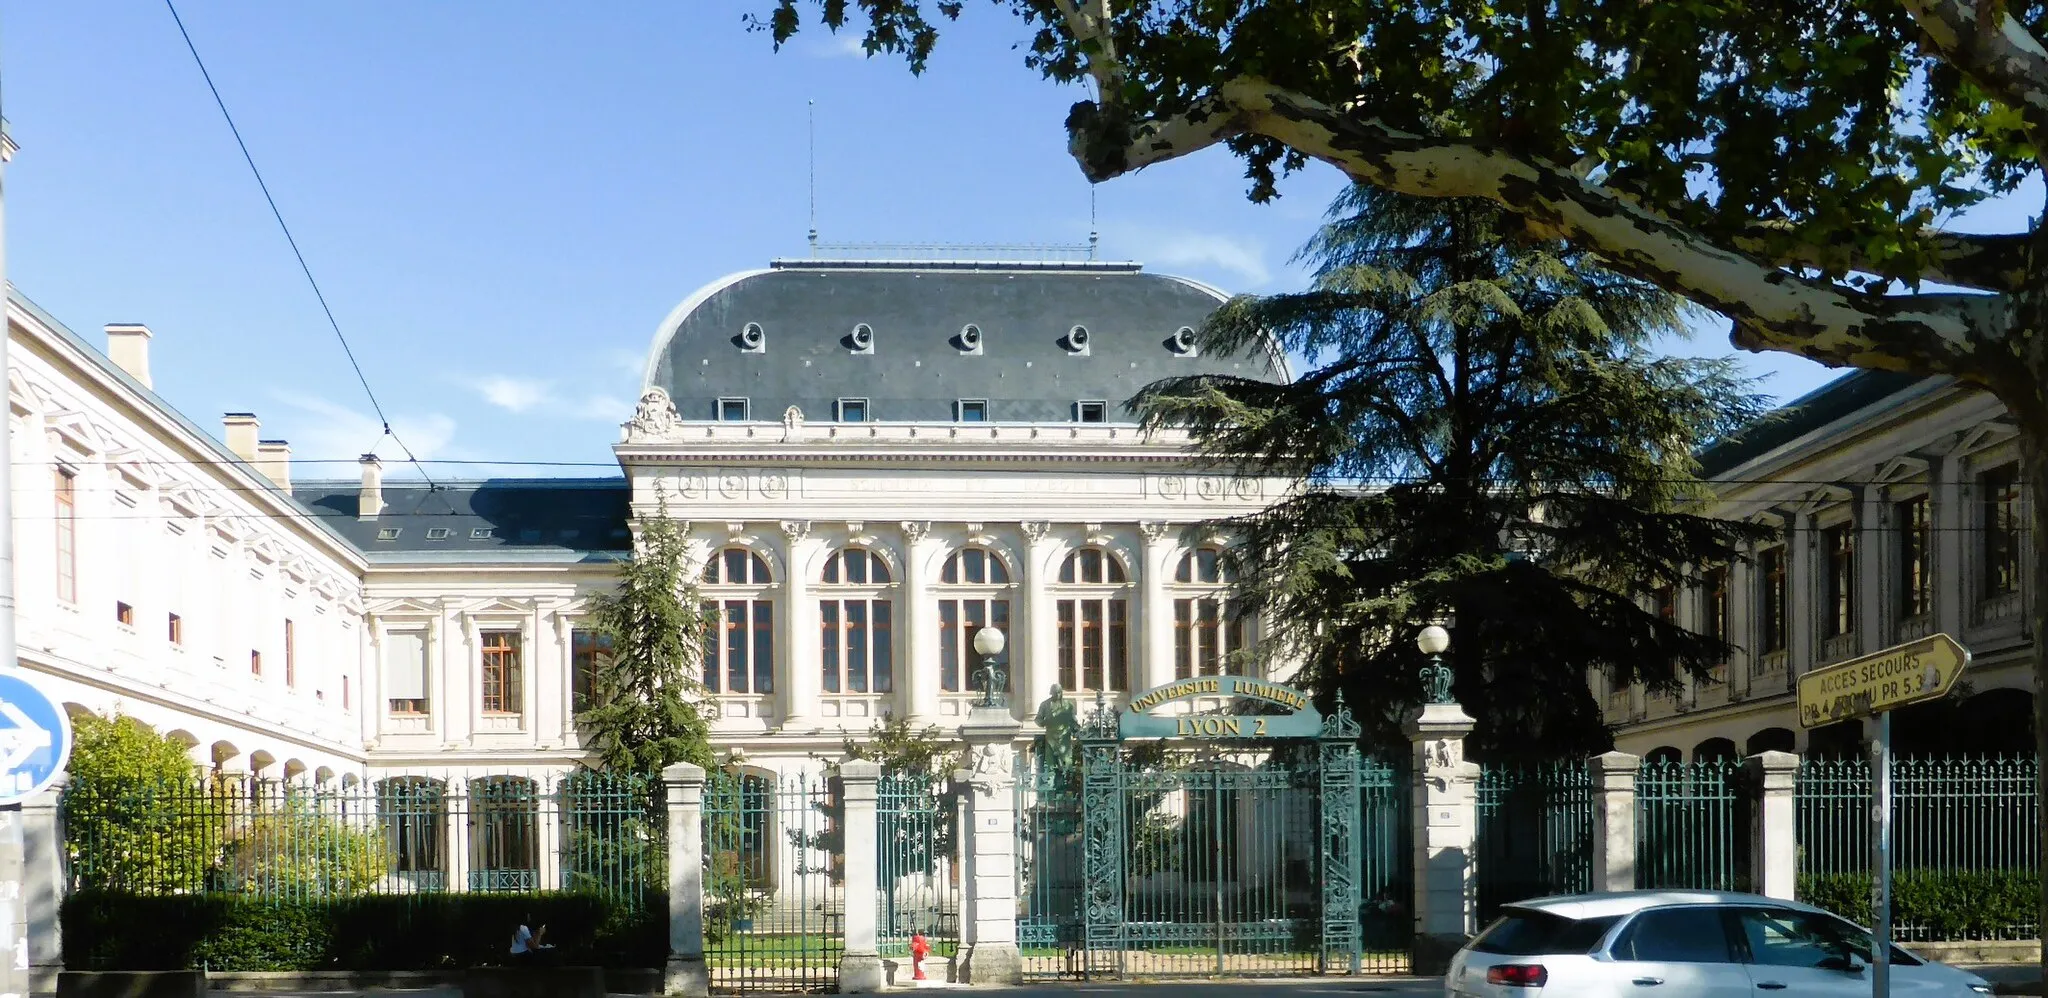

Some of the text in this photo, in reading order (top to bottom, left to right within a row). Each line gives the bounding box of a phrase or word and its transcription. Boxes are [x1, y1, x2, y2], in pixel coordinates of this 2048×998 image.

[1820, 653, 1920, 695] ACCES SECOURS
[1129, 680, 1307, 714] UNIVERSITE LUMIERE
[1882, 680, 1898, 701] PR
[1176, 718, 1268, 737] LYON 2
